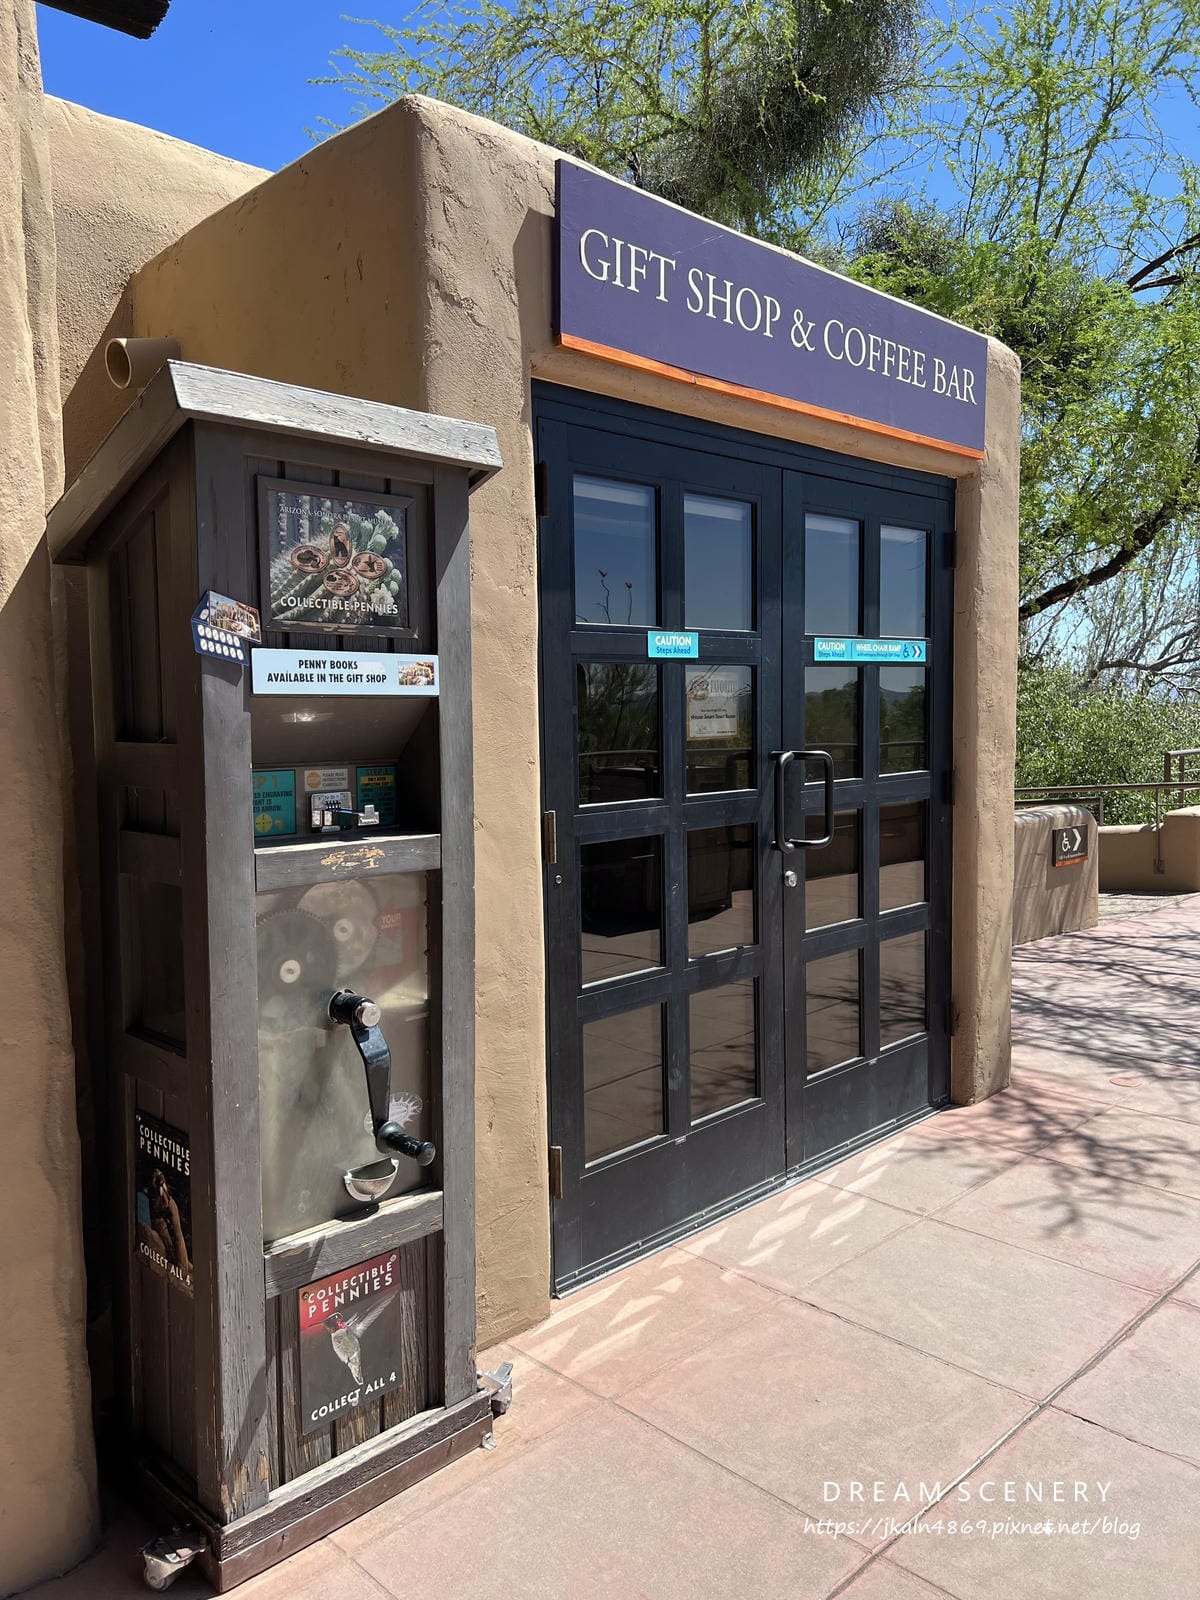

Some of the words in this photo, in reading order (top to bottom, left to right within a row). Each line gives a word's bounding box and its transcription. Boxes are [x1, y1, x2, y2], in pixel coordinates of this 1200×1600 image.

[580, 228, 676, 303] GIFT
[686, 267, 781, 338] SHOP
[790, 308, 816, 352] &
[823, 319, 927, 388] COFFEE
[932, 358, 977, 405] BAR
[280, 596, 350, 611] COLLECTIBLE
[353, 601, 399, 614] PENNIES
[655, 635, 692, 646] CAUTION
[817, 641, 846, 651] CAUTION
[856, 643, 872, 652] WHEEL
[873, 644, 888, 652] CHAIR
[888, 644, 901, 652] RAMP
[656, 646, 672, 656] Steps
[673, 646, 691, 655] Ahead
[818, 651, 830, 659] Steps
[299, 659, 327, 669] PENNY
[330, 660, 358, 670] BOOKS
[267, 672, 314, 683] AVAILABLE
[317, 673, 326, 683] IN
[329, 673, 343, 683] THE
[346, 674, 363, 683] GIFT
[366, 674, 387, 683] SHOP
[139, 1124, 190, 1161] COLLECTIBLE
[140, 1137, 190, 1176] PENNIES
[140, 1242, 168, 1270] COLLECT
[170, 1265, 184, 1281] ALL
[185, 1275, 191, 1286] 4
[308, 1261, 393, 1304] COLLECTIBLE
[308, 1273, 393, 1318] PENNIES
[311, 1389, 361, 1421] COLLECT
[365, 1378, 385, 1395] ALL
[389, 1371, 397, 1382] 4
